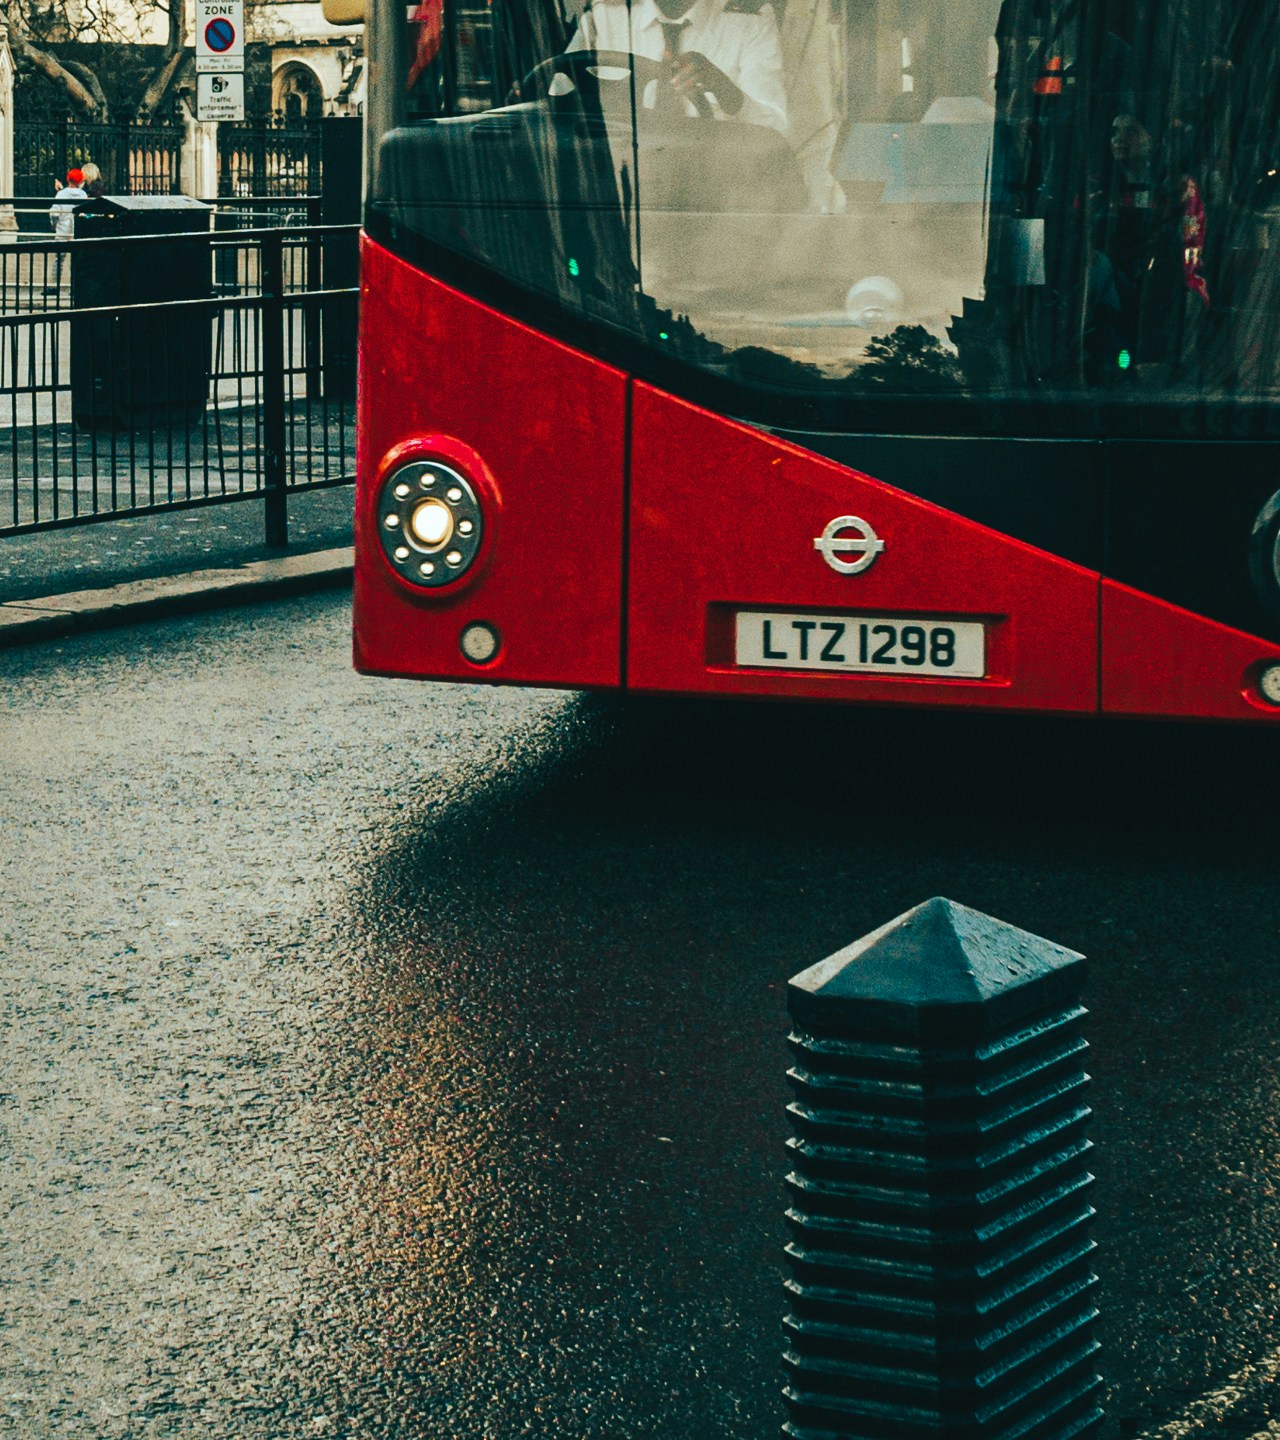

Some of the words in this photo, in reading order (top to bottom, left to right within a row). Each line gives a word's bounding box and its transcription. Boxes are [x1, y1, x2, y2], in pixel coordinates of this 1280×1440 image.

[204, 5, 234, 15] ZONE
[763, 619, 845, 662] LTZ
[858, 623, 956, 668] 1298
